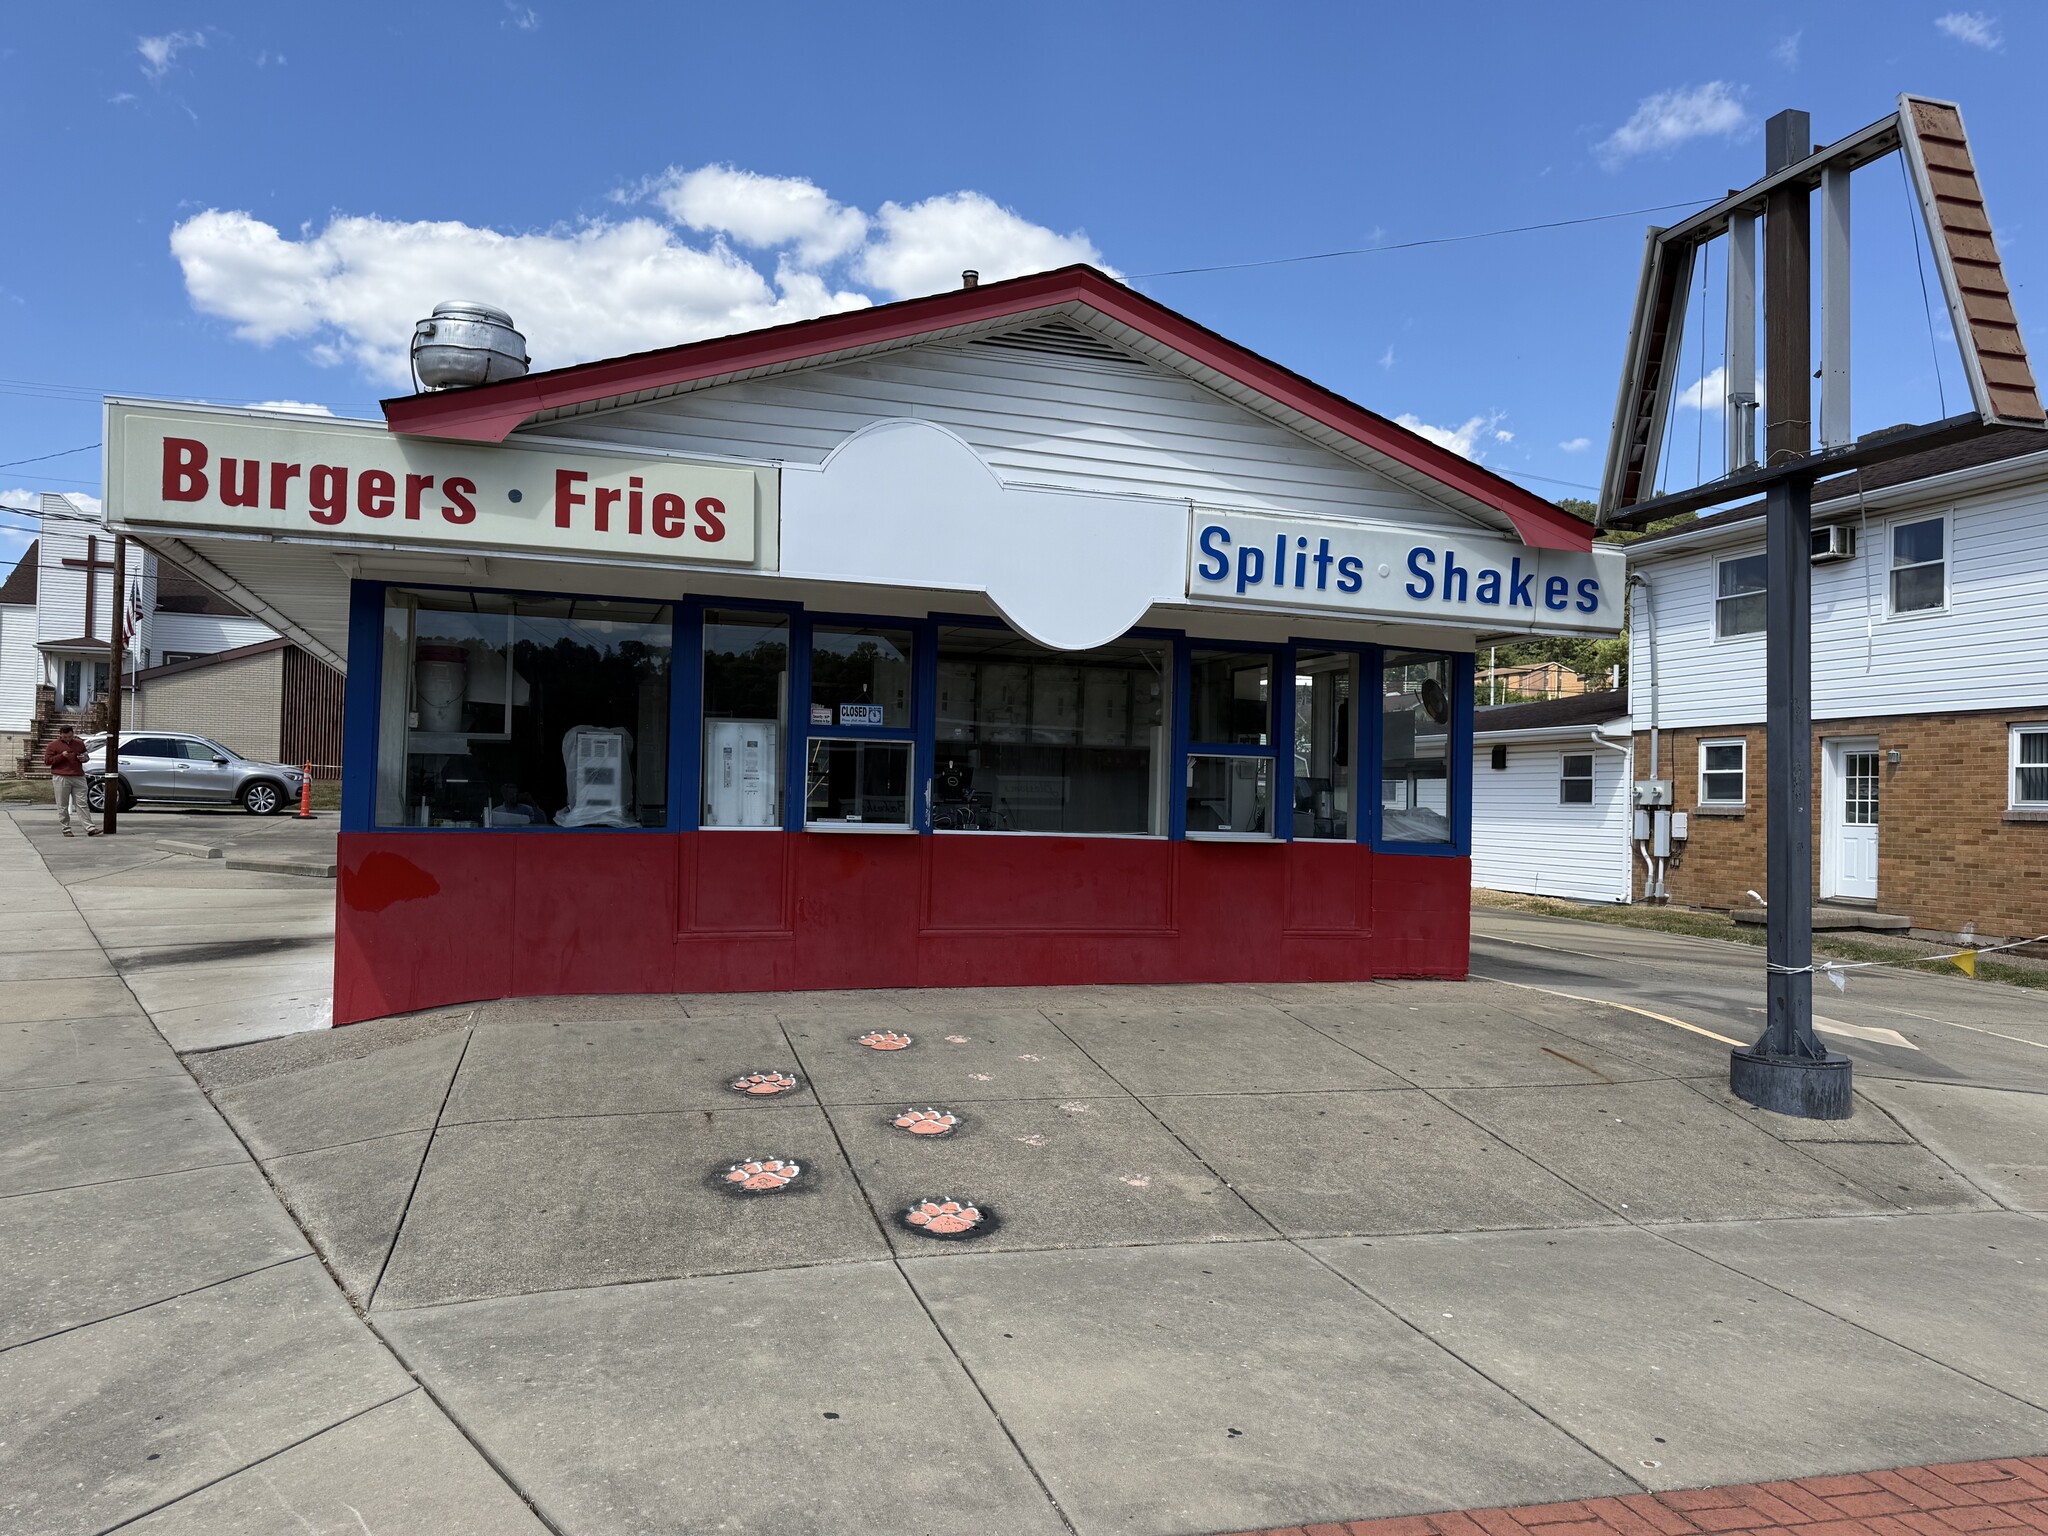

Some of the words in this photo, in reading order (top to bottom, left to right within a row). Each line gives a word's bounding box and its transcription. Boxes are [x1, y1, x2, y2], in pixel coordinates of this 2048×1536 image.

[162, 436, 477, 526] Burgers
[555, 468, 726, 543] Fries
[1197, 525, 1364, 594] Splits
[1405, 546, 1600, 613] Shakes
[841, 706, 867, 717] CLOSED
